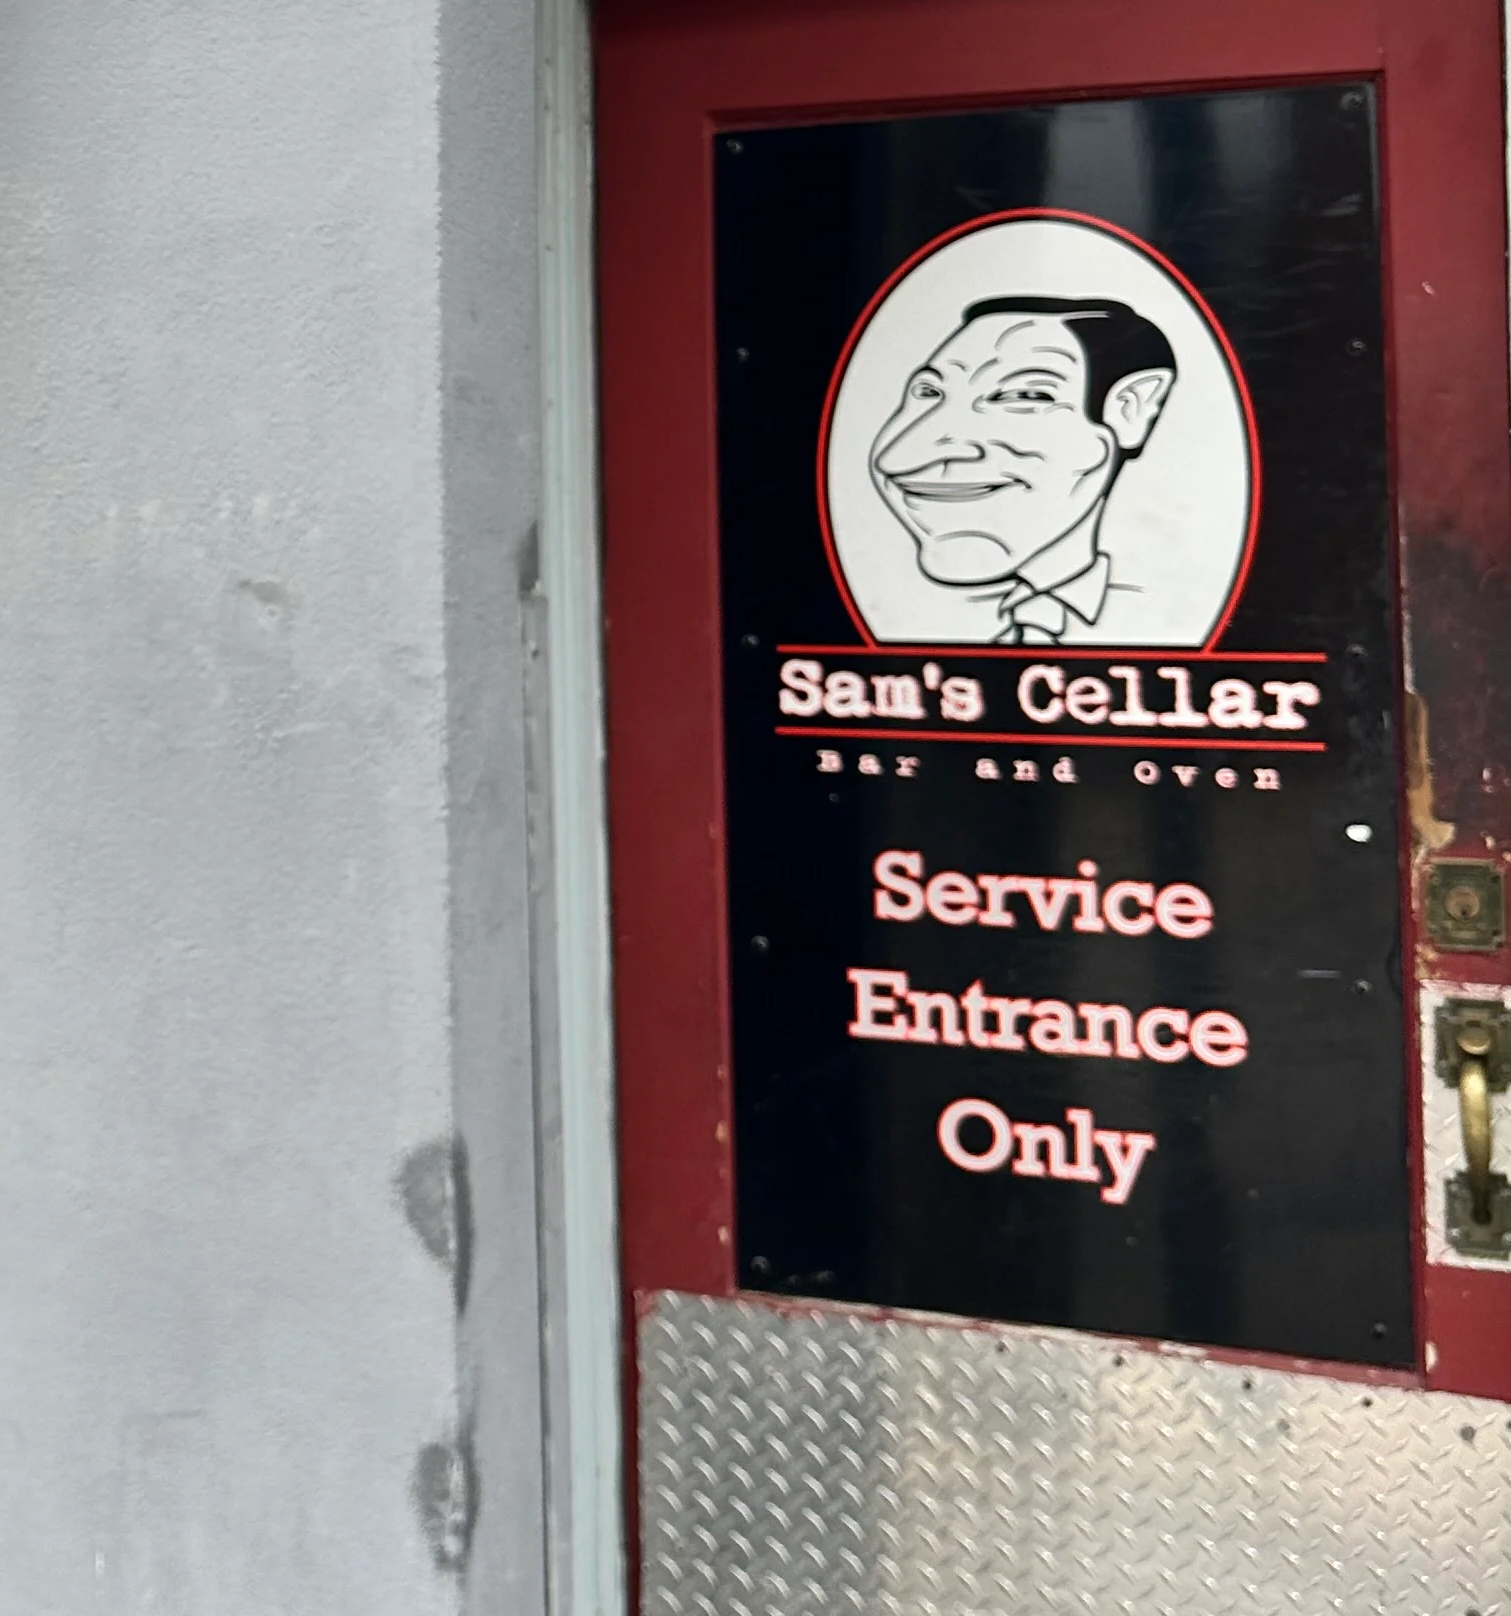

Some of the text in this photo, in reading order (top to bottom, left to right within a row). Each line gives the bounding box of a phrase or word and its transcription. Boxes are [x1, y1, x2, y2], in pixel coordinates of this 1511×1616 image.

[778, 659, 1321, 730] Sam's Cellar
[816, 749, 921, 778] Bar
[975, 756, 1078, 784] and
[873, 849, 1215, 939] Service
[846, 967, 1249, 1068] Entrance
[936, 1098, 1157, 1205] Only
